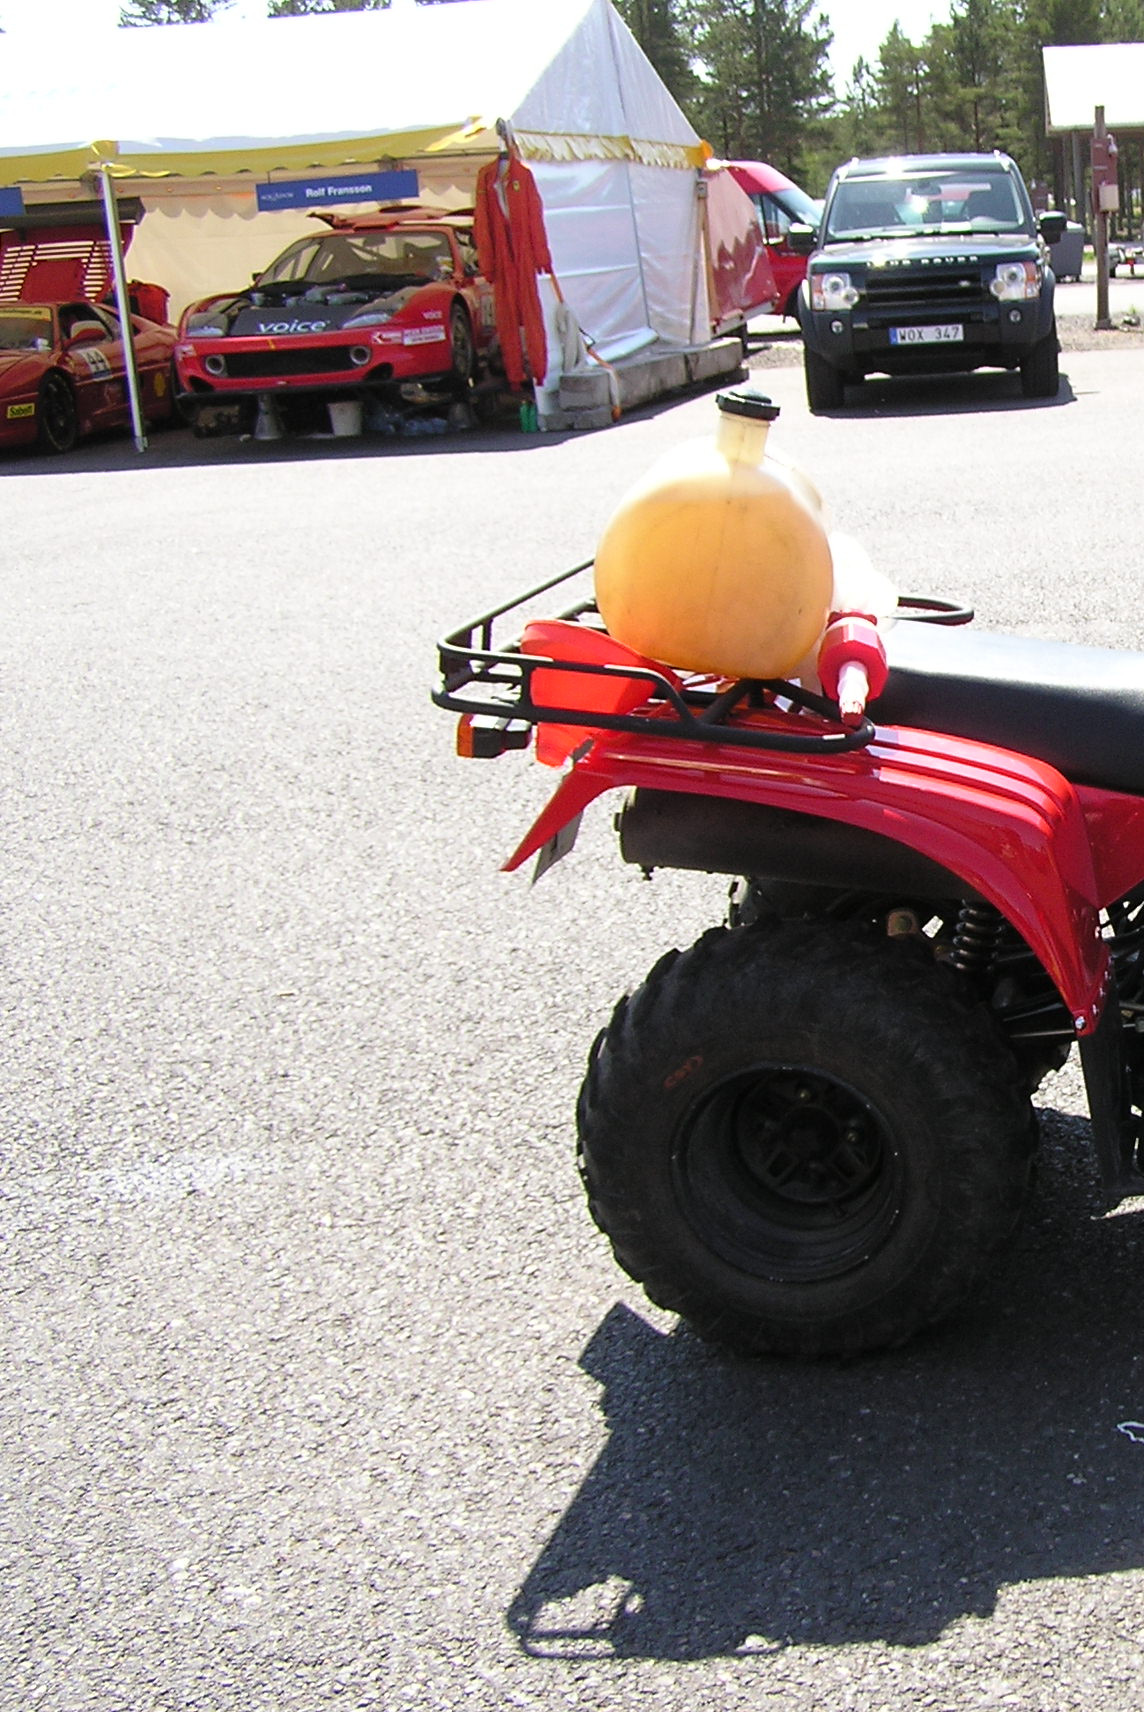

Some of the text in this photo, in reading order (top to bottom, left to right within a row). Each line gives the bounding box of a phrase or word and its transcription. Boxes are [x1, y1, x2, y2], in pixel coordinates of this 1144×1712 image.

[305, 187, 325, 198] Rolf
[327, 184, 372, 196] Fransson
[921, 255, 978, 264] ROVER
[259, 319, 326, 334] voice
[899, 327, 960, 341] WOX 347
